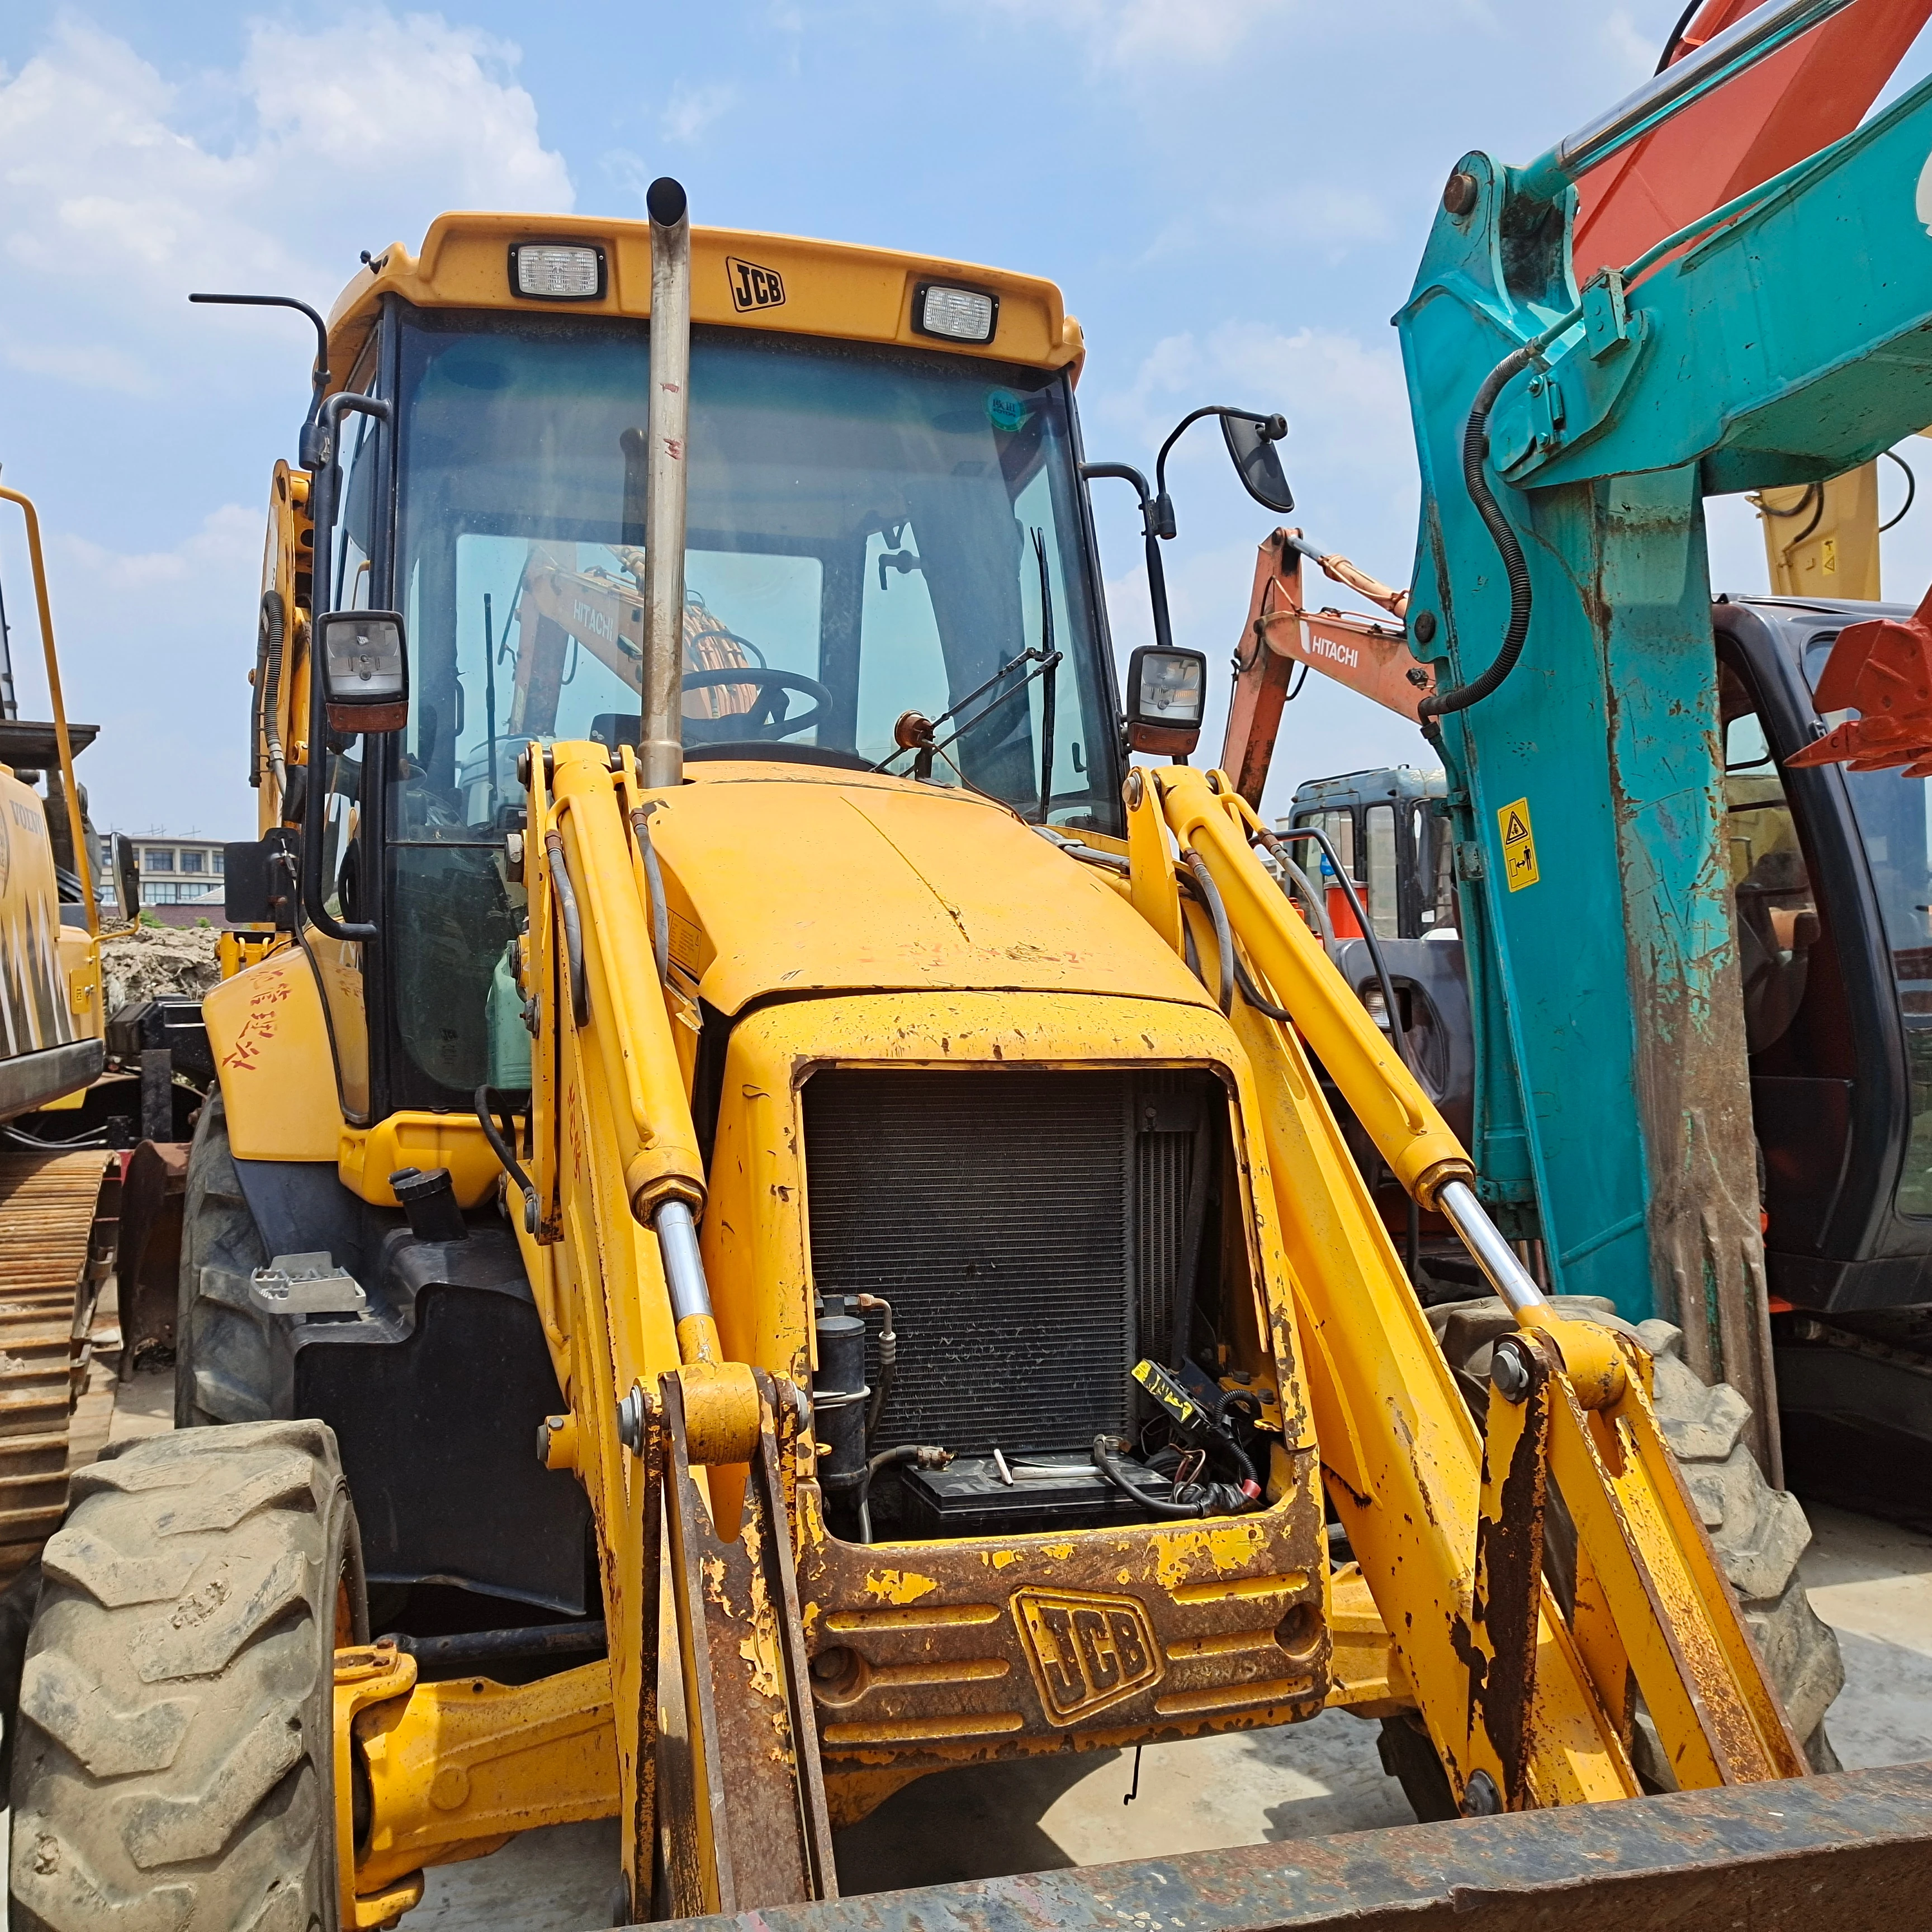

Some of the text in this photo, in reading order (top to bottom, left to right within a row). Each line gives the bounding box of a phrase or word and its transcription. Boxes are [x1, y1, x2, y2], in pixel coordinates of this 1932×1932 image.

[736, 263, 781, 306] JCB
[574, 599, 613, 642] HITACHI
[1312, 635, 1358, 668] HITACHI
[9, 799, 44, 836] VOLVO
[1038, 1606, 1148, 1705] JCB
